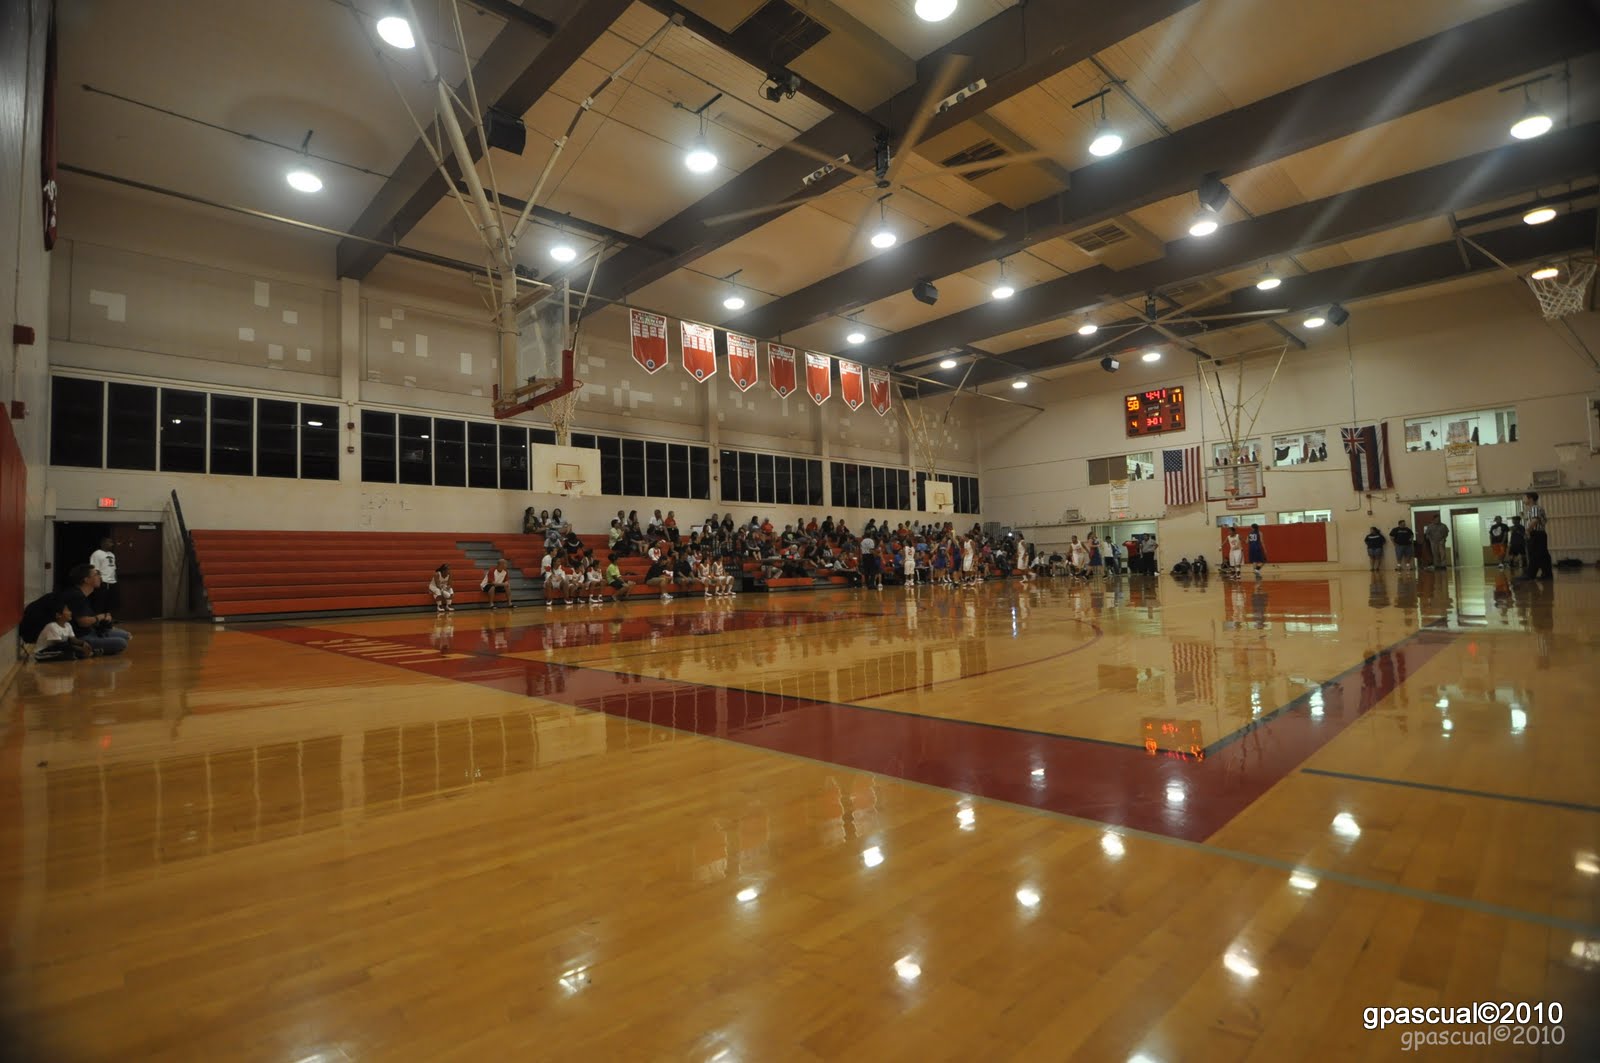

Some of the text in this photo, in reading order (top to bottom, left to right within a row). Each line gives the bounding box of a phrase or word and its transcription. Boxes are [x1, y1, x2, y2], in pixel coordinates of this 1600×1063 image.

[1146, 390, 1166, 400] 4:41
[1172, 393, 1182, 403] 11
[1128, 401, 1139, 411] 58
